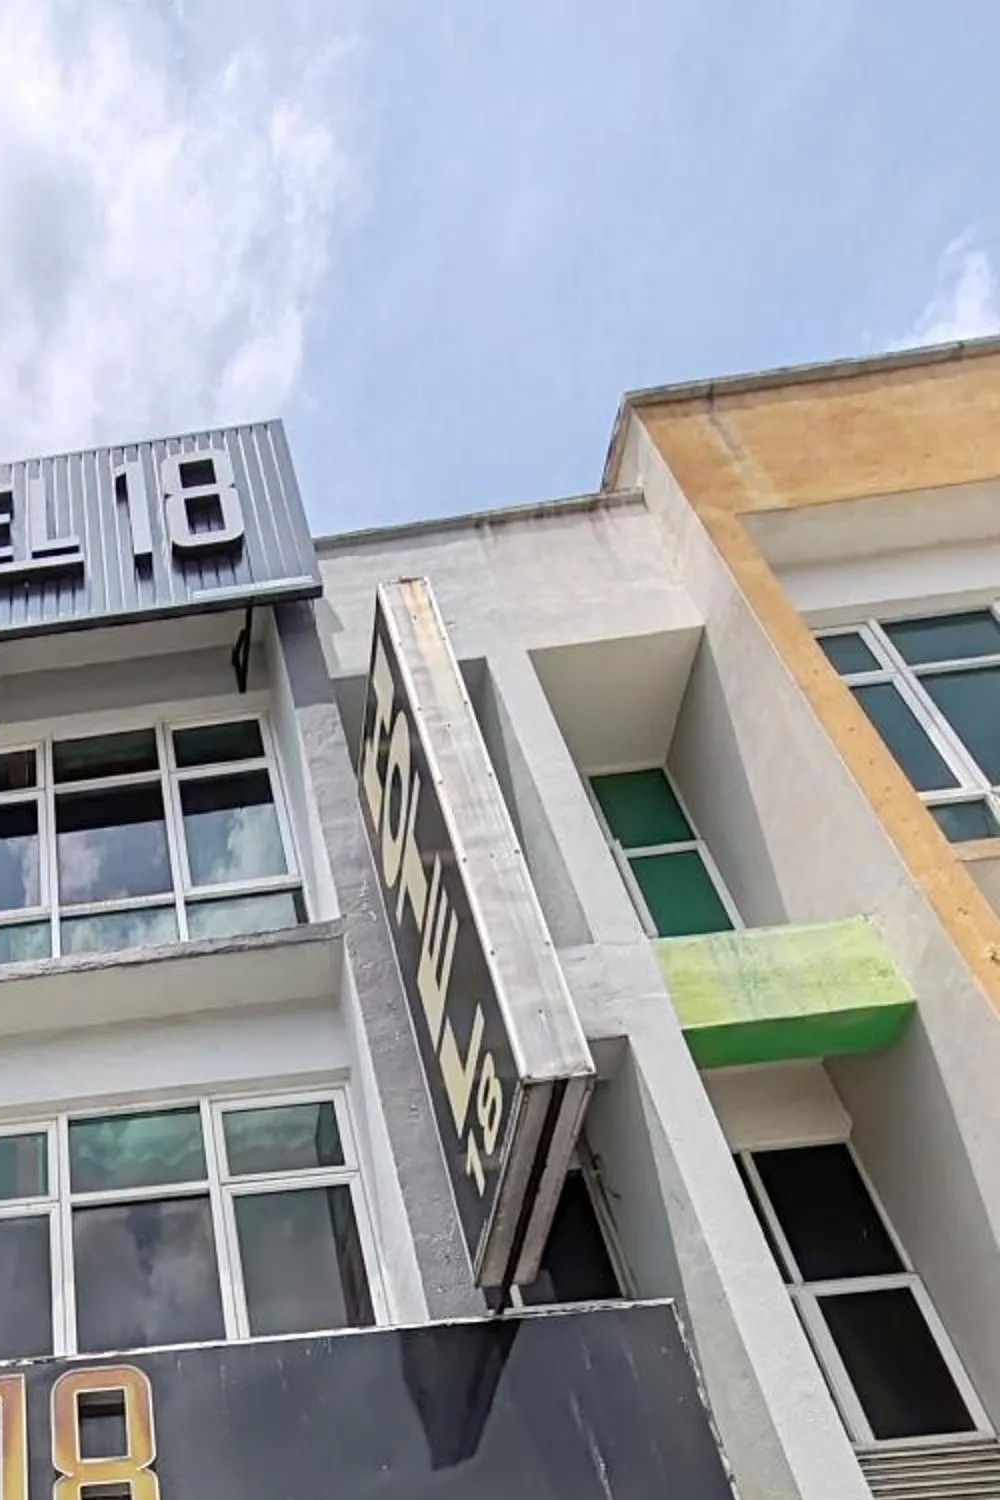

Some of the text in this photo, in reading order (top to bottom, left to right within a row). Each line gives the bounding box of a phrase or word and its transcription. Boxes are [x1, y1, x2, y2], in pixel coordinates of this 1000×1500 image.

[113, 447, 246, 572] 18
[362, 634, 502, 1199] HOTEL 18
